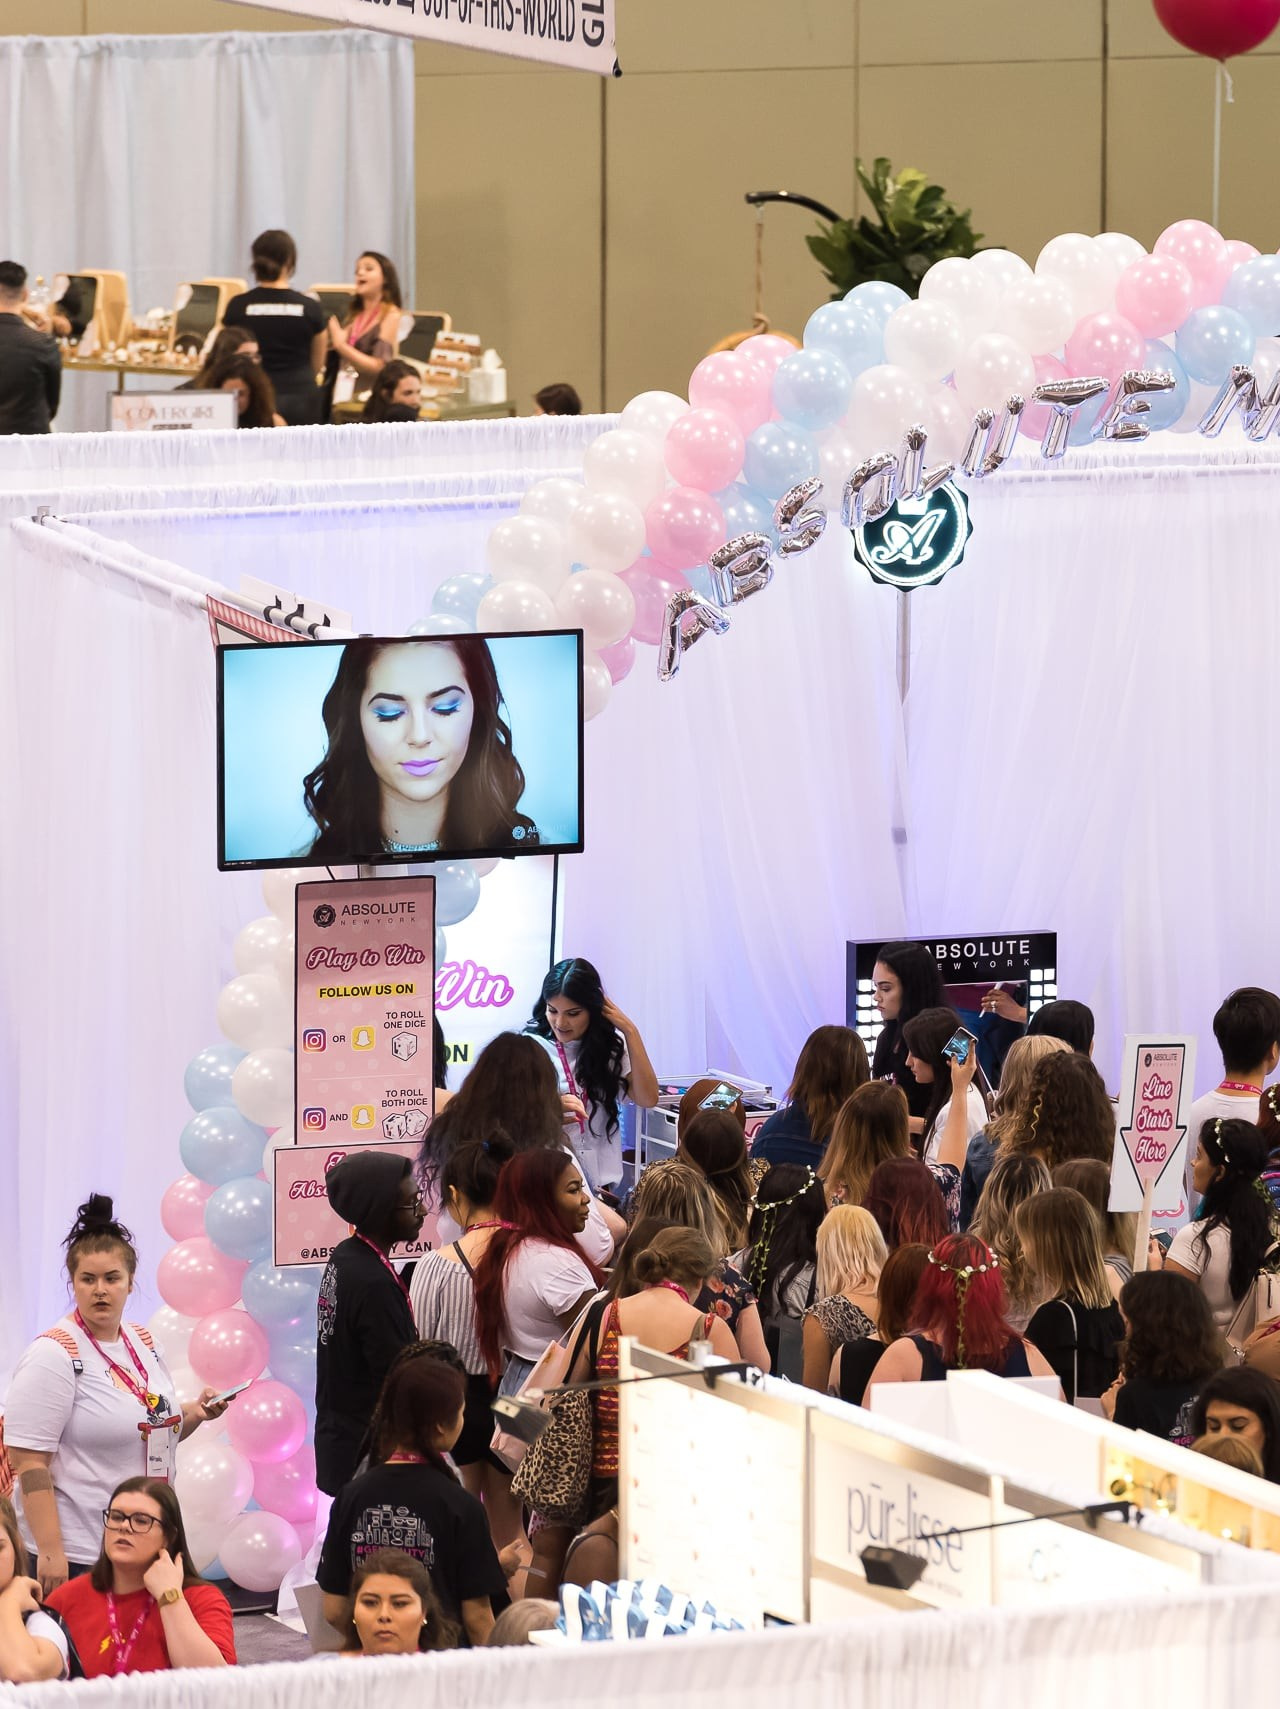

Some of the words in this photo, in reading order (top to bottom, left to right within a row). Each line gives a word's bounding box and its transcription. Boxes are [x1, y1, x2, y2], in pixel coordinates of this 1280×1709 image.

[656, 368, 1177, 682] ABSOLUTE
[341, 902, 416, 916] ABSOLUTE
[925, 940, 1030, 959] BSOLUTE
[306, 947, 357, 972] Play
[359, 949, 380, 967] to
[384, 944, 426, 966] Win
[319, 986, 371, 998] FOLLOW
[375, 984, 392, 996] US
[395, 983, 414, 994] ON
[386, 1012, 398, 1020] TO
[400, 1010, 424, 1019] ROLL
[383, 1020, 402, 1029] ONE
[404, 1019, 426, 1028] DICE
[332, 1035, 346, 1043] OR
[386, 1090, 398, 1098] TO
[400, 1089, 424, 1097] ROLL
[1142, 1074, 1173, 1101] Line
[382, 1099, 405, 1108] BOTH
[407, 1097, 428, 1106] DICE
[329, 1113, 349, 1122] AND
[1136, 1106, 1173, 1133] Starts
[1135, 1136, 1167, 1164] Here
